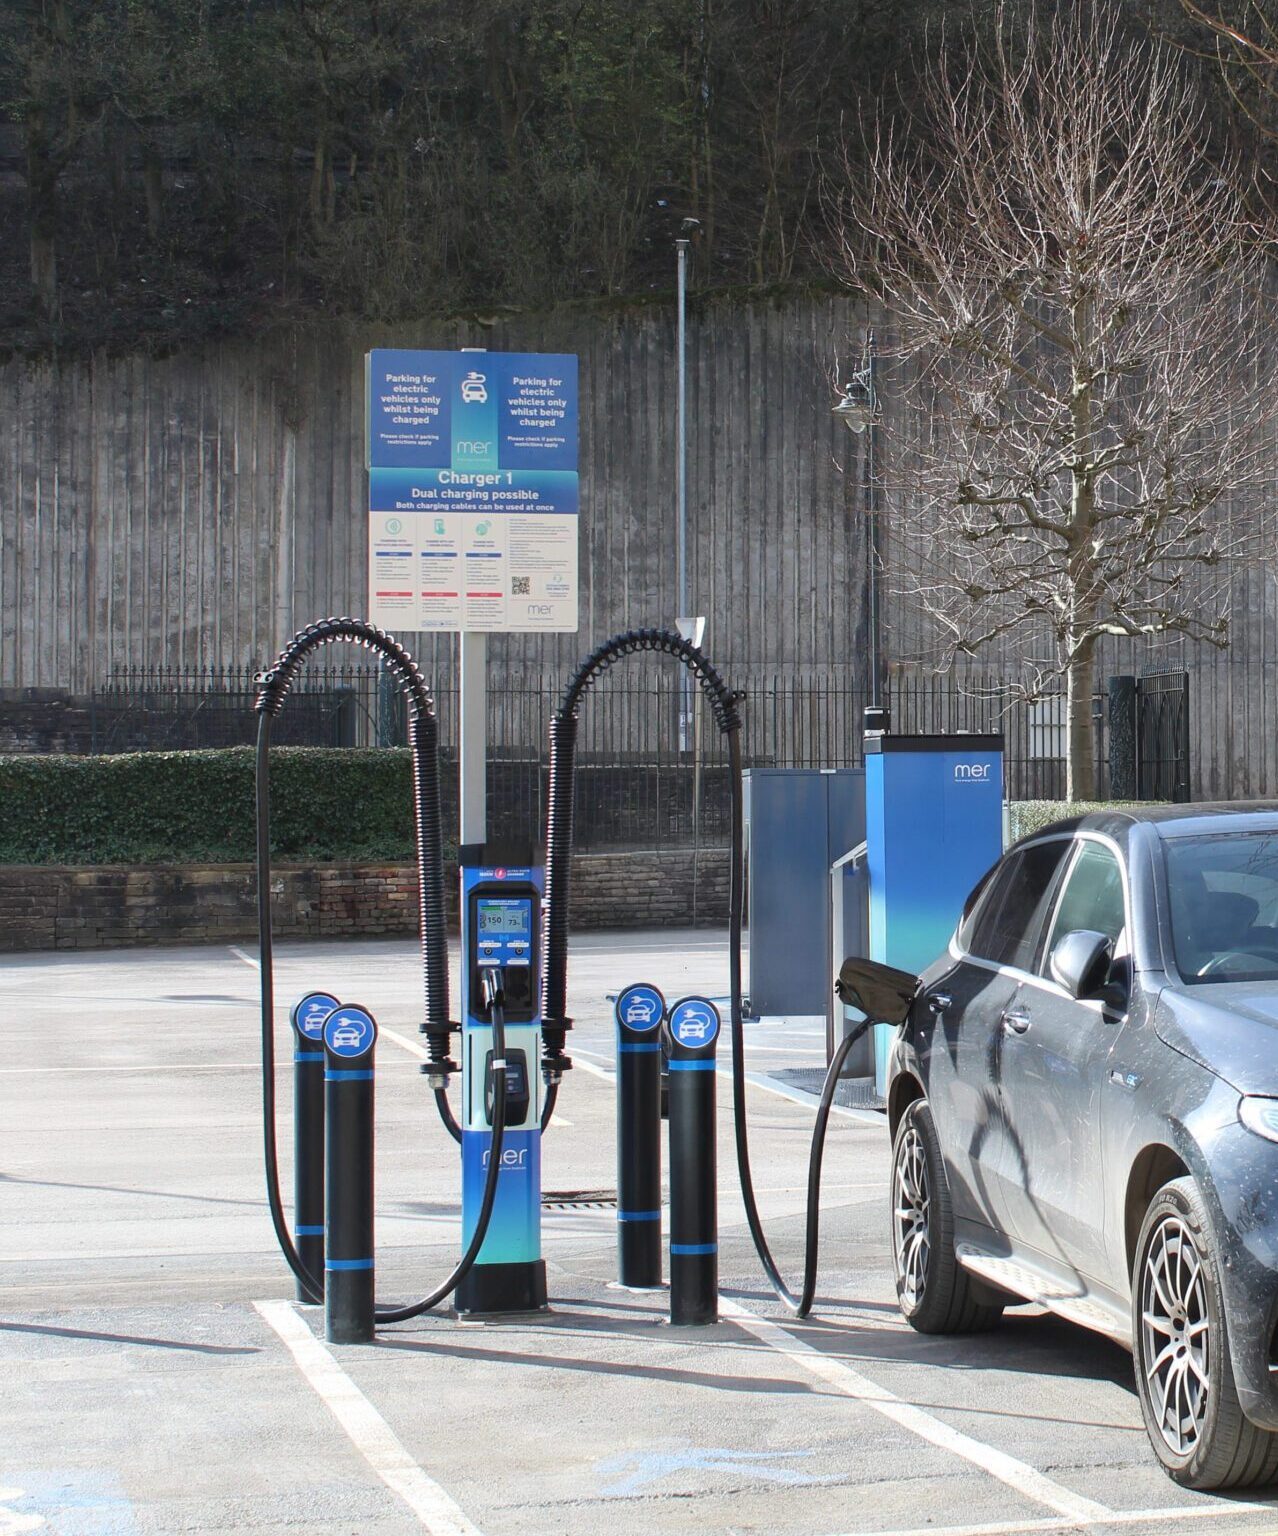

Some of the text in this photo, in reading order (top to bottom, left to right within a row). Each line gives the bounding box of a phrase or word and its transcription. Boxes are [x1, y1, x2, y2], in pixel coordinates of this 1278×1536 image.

[386, 374, 436, 384] Parking for
[513, 376, 562, 387] Parking for
[393, 385, 429, 393] electric
[520, 388, 555, 396] electric
[380, 395, 440, 405] vehicles only
[508, 398, 567, 407] vehicles only
[384, 405, 439, 415] whilst being
[510, 408, 564, 418] whilst being
[392, 415, 430, 425] charged
[520, 418, 556, 427] charged
[457, 441, 491, 454] mer
[438, 470, 513, 486] Charger 1
[411, 488, 539, 501] Dual charging possible
[416, 502, 449, 510] charging
[528, 604, 554, 615] mer
[954, 764, 991, 777] mer
